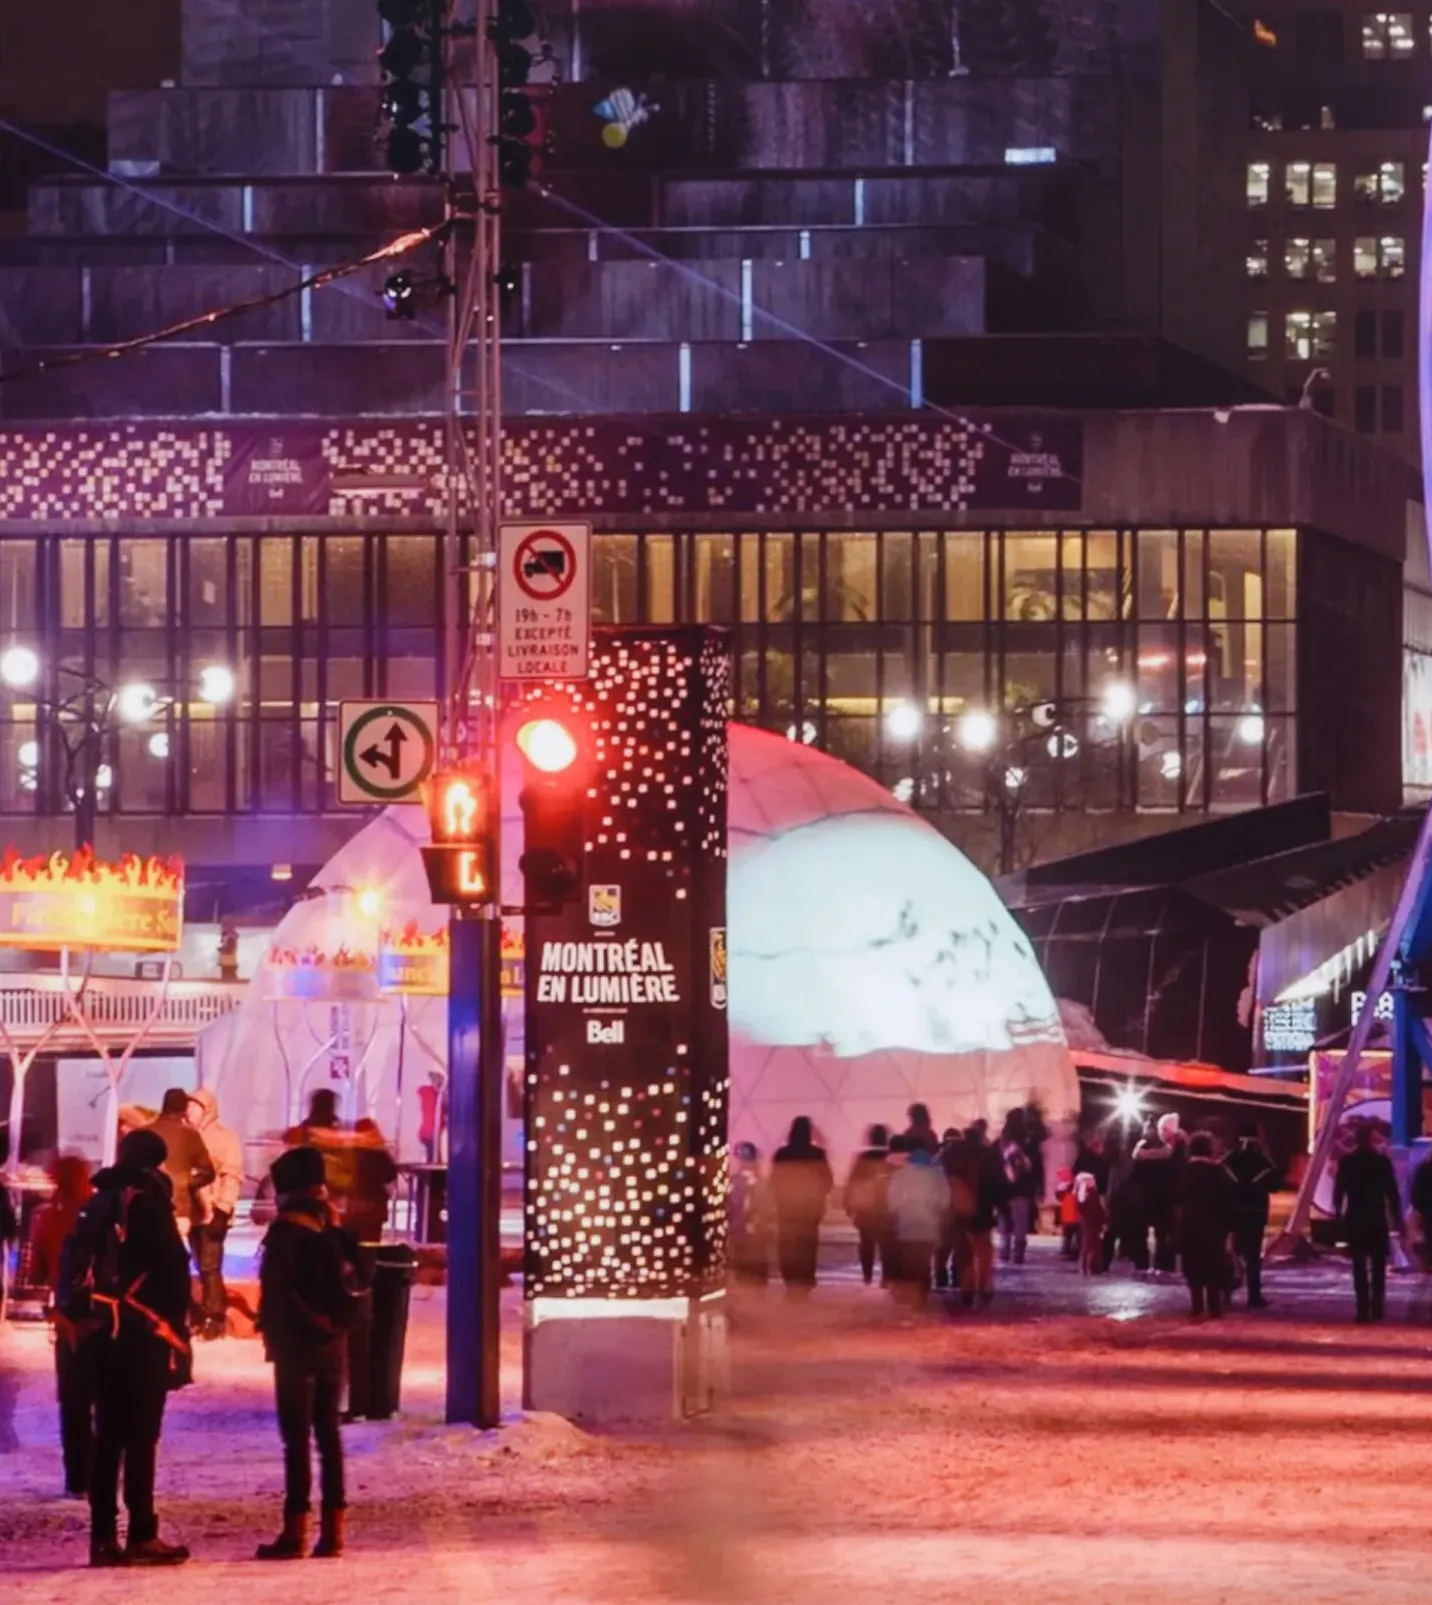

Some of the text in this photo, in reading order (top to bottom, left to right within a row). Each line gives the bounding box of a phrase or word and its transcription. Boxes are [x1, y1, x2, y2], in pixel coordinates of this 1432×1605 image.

[515, 608, 538, 623] 19h
[555, 608, 572, 622] 7h
[515, 625, 572, 641] EXCEPTÉ
[507, 644, 578, 657] LIVRAISON
[517, 661, 567, 674] LOCALE
[540, 938, 674, 973] MONTRÉAL
[537, 974, 567, 1003] EN
[571, 972, 680, 1003] LUMIÈRE
[587, 1020, 625, 1043] Bell
